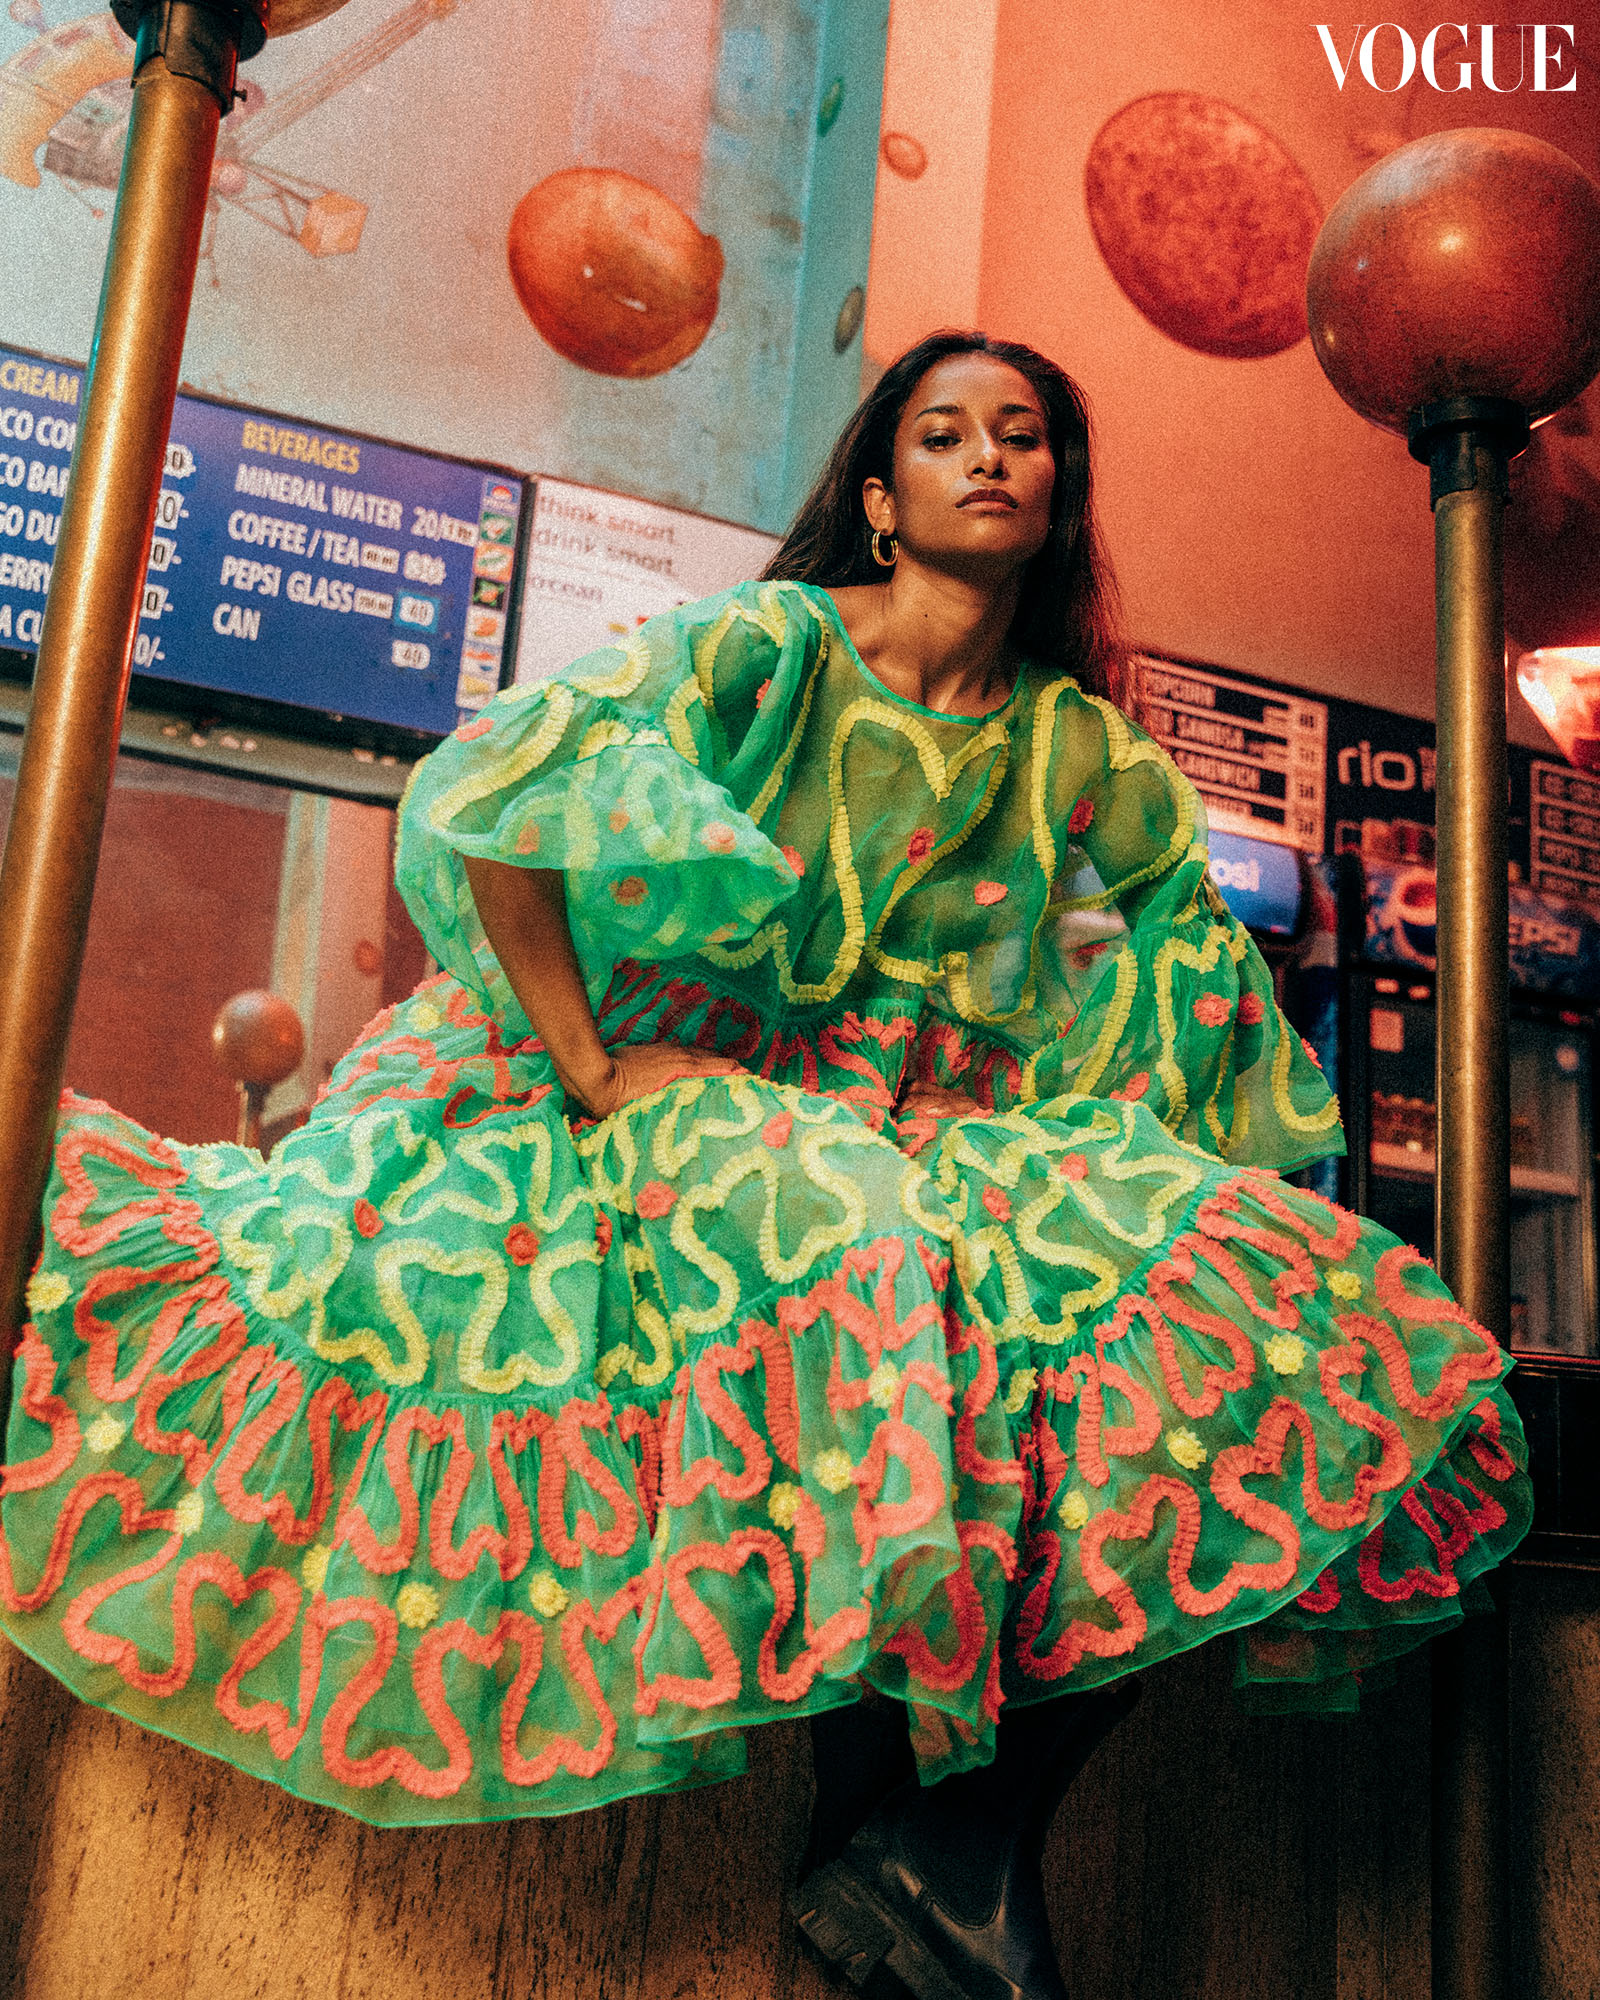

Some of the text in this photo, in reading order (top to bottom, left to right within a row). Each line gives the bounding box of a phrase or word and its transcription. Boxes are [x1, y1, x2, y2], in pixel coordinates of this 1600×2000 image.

[0, 360, 79, 405] CREAM
[241, 421, 361, 475] BEVERAGES
[234, 463, 328, 513] MINERAL
[331, 485, 403, 531] WATER
[220, 554, 282, 597] PEPSI
[286, 570, 355, 613] GLASS
[212, 602, 261, 641] CAN
[1337, 740, 1417, 792] rio
